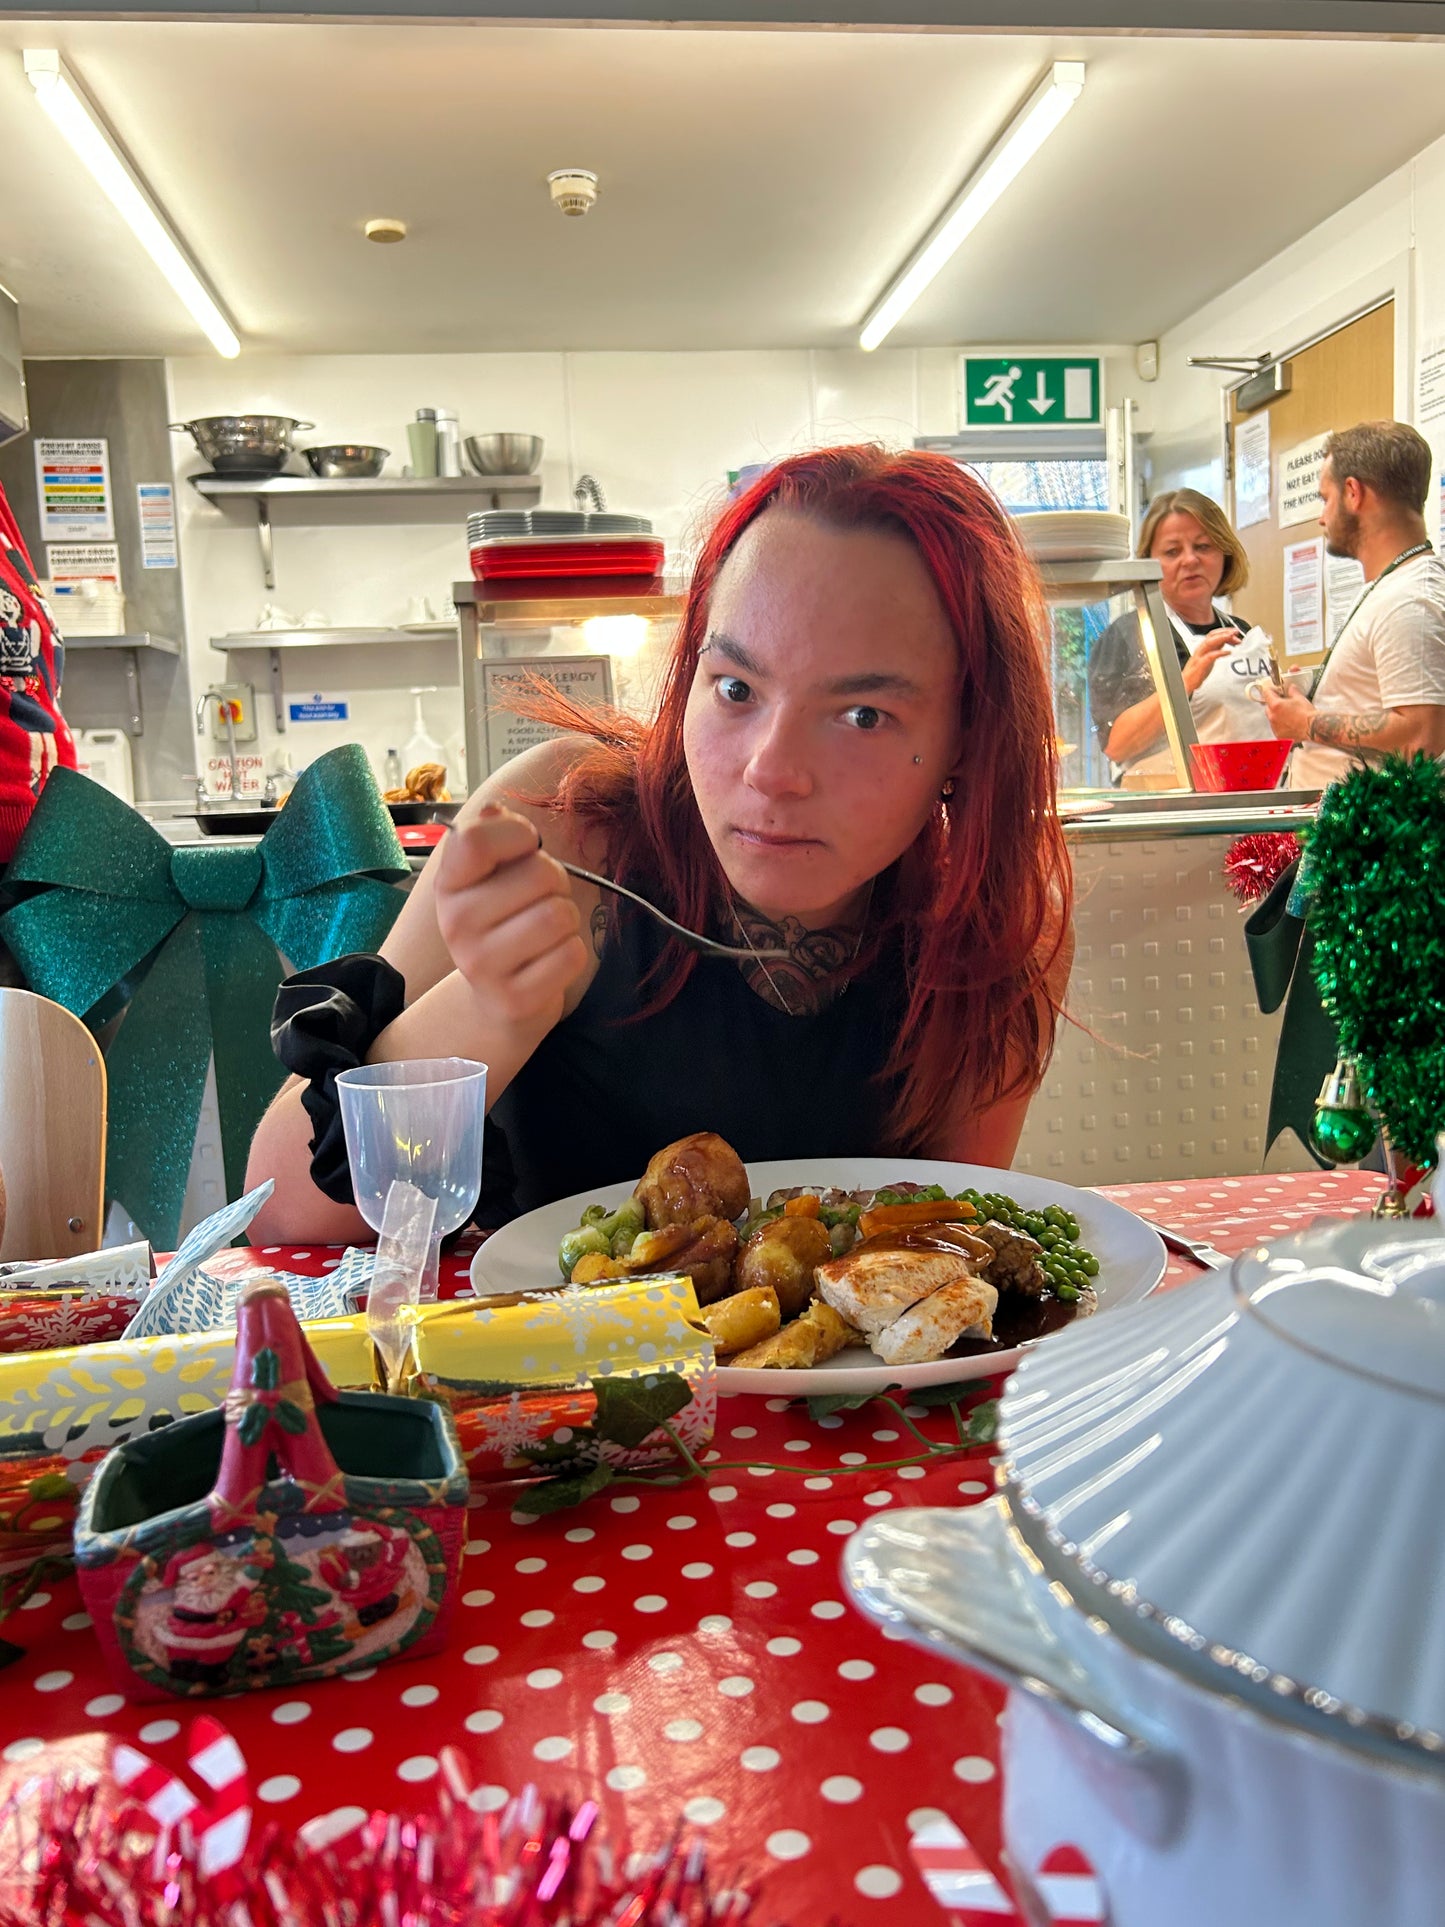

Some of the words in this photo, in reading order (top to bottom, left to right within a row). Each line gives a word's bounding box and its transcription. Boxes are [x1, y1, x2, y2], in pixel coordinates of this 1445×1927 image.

[1286, 452, 1313, 472] PLEASE
[1286, 476, 1301, 490] NOT
[1302, 471, 1315, 486] EAT
[1283, 496, 1297, 510] THE
[208, 756, 263, 771] CAUTION
